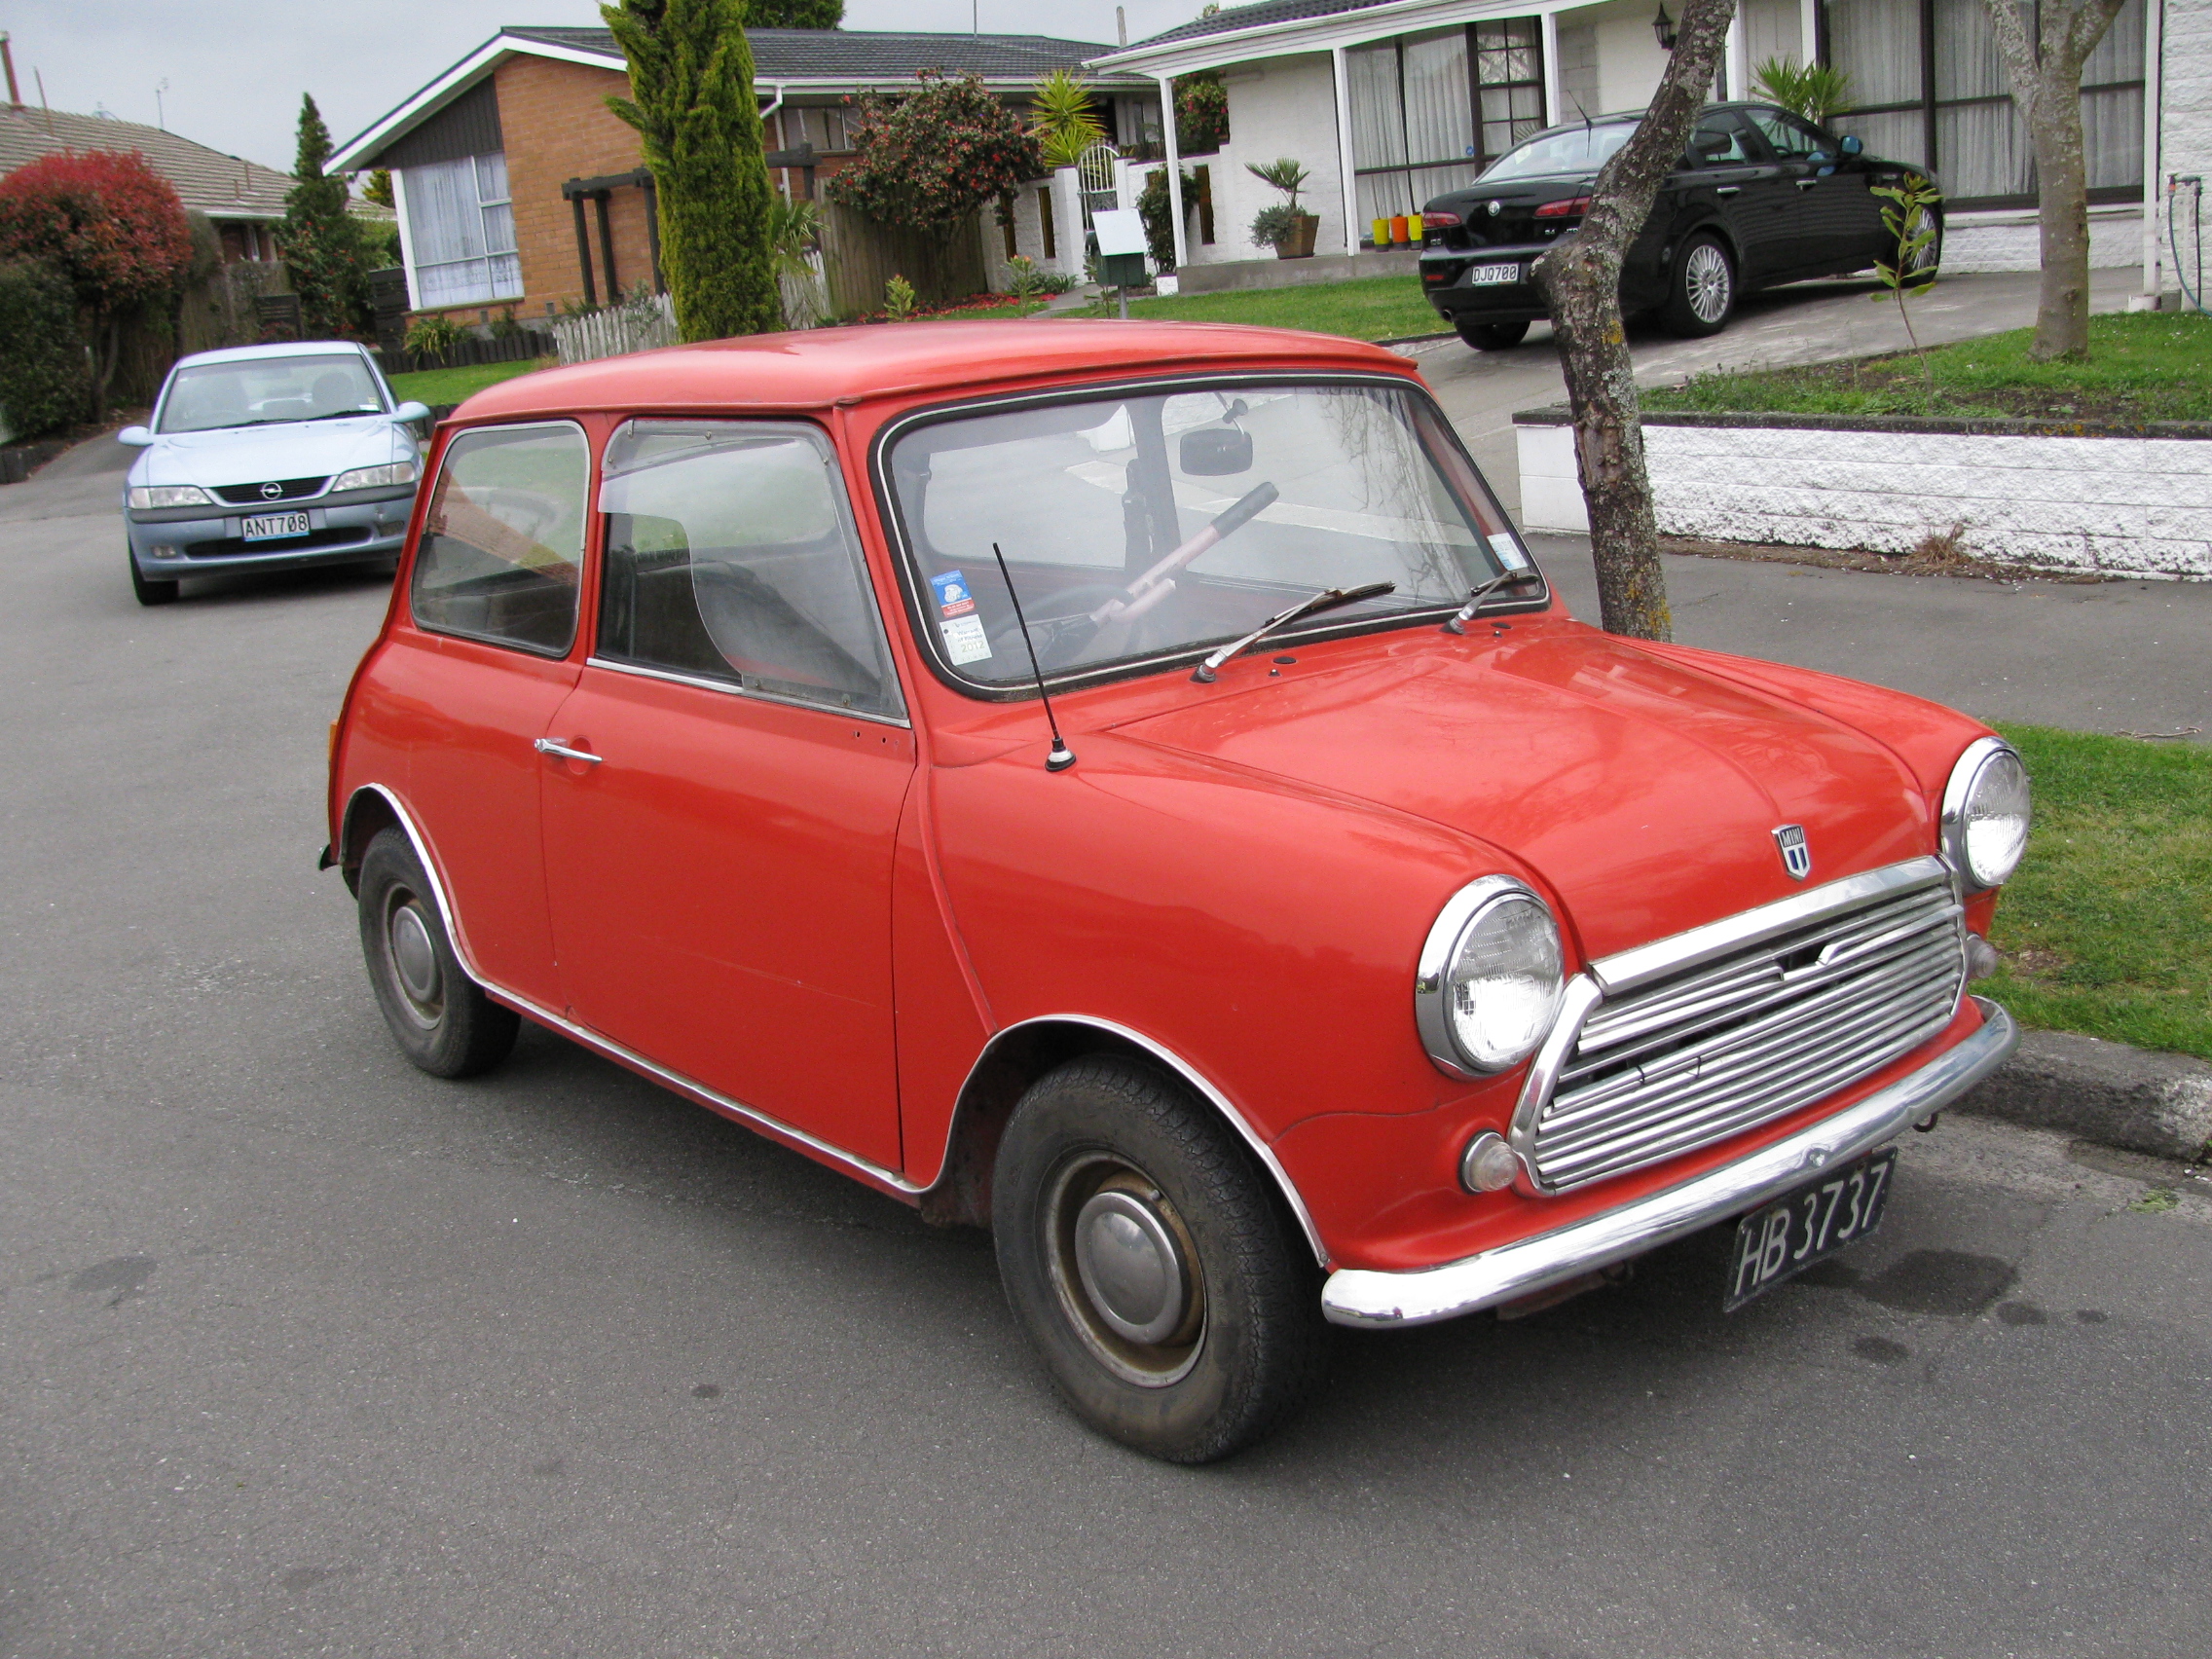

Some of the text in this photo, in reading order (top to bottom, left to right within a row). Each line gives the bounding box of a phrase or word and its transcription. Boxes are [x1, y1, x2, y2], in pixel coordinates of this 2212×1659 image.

[1473, 266, 1517, 282] DJQ700
[245, 514, 308, 536] ANT708
[961, 640, 985, 653] 2012
[1782, 828, 1802, 847] MINI
[1734, 1161, 1889, 1296] HB 3737
